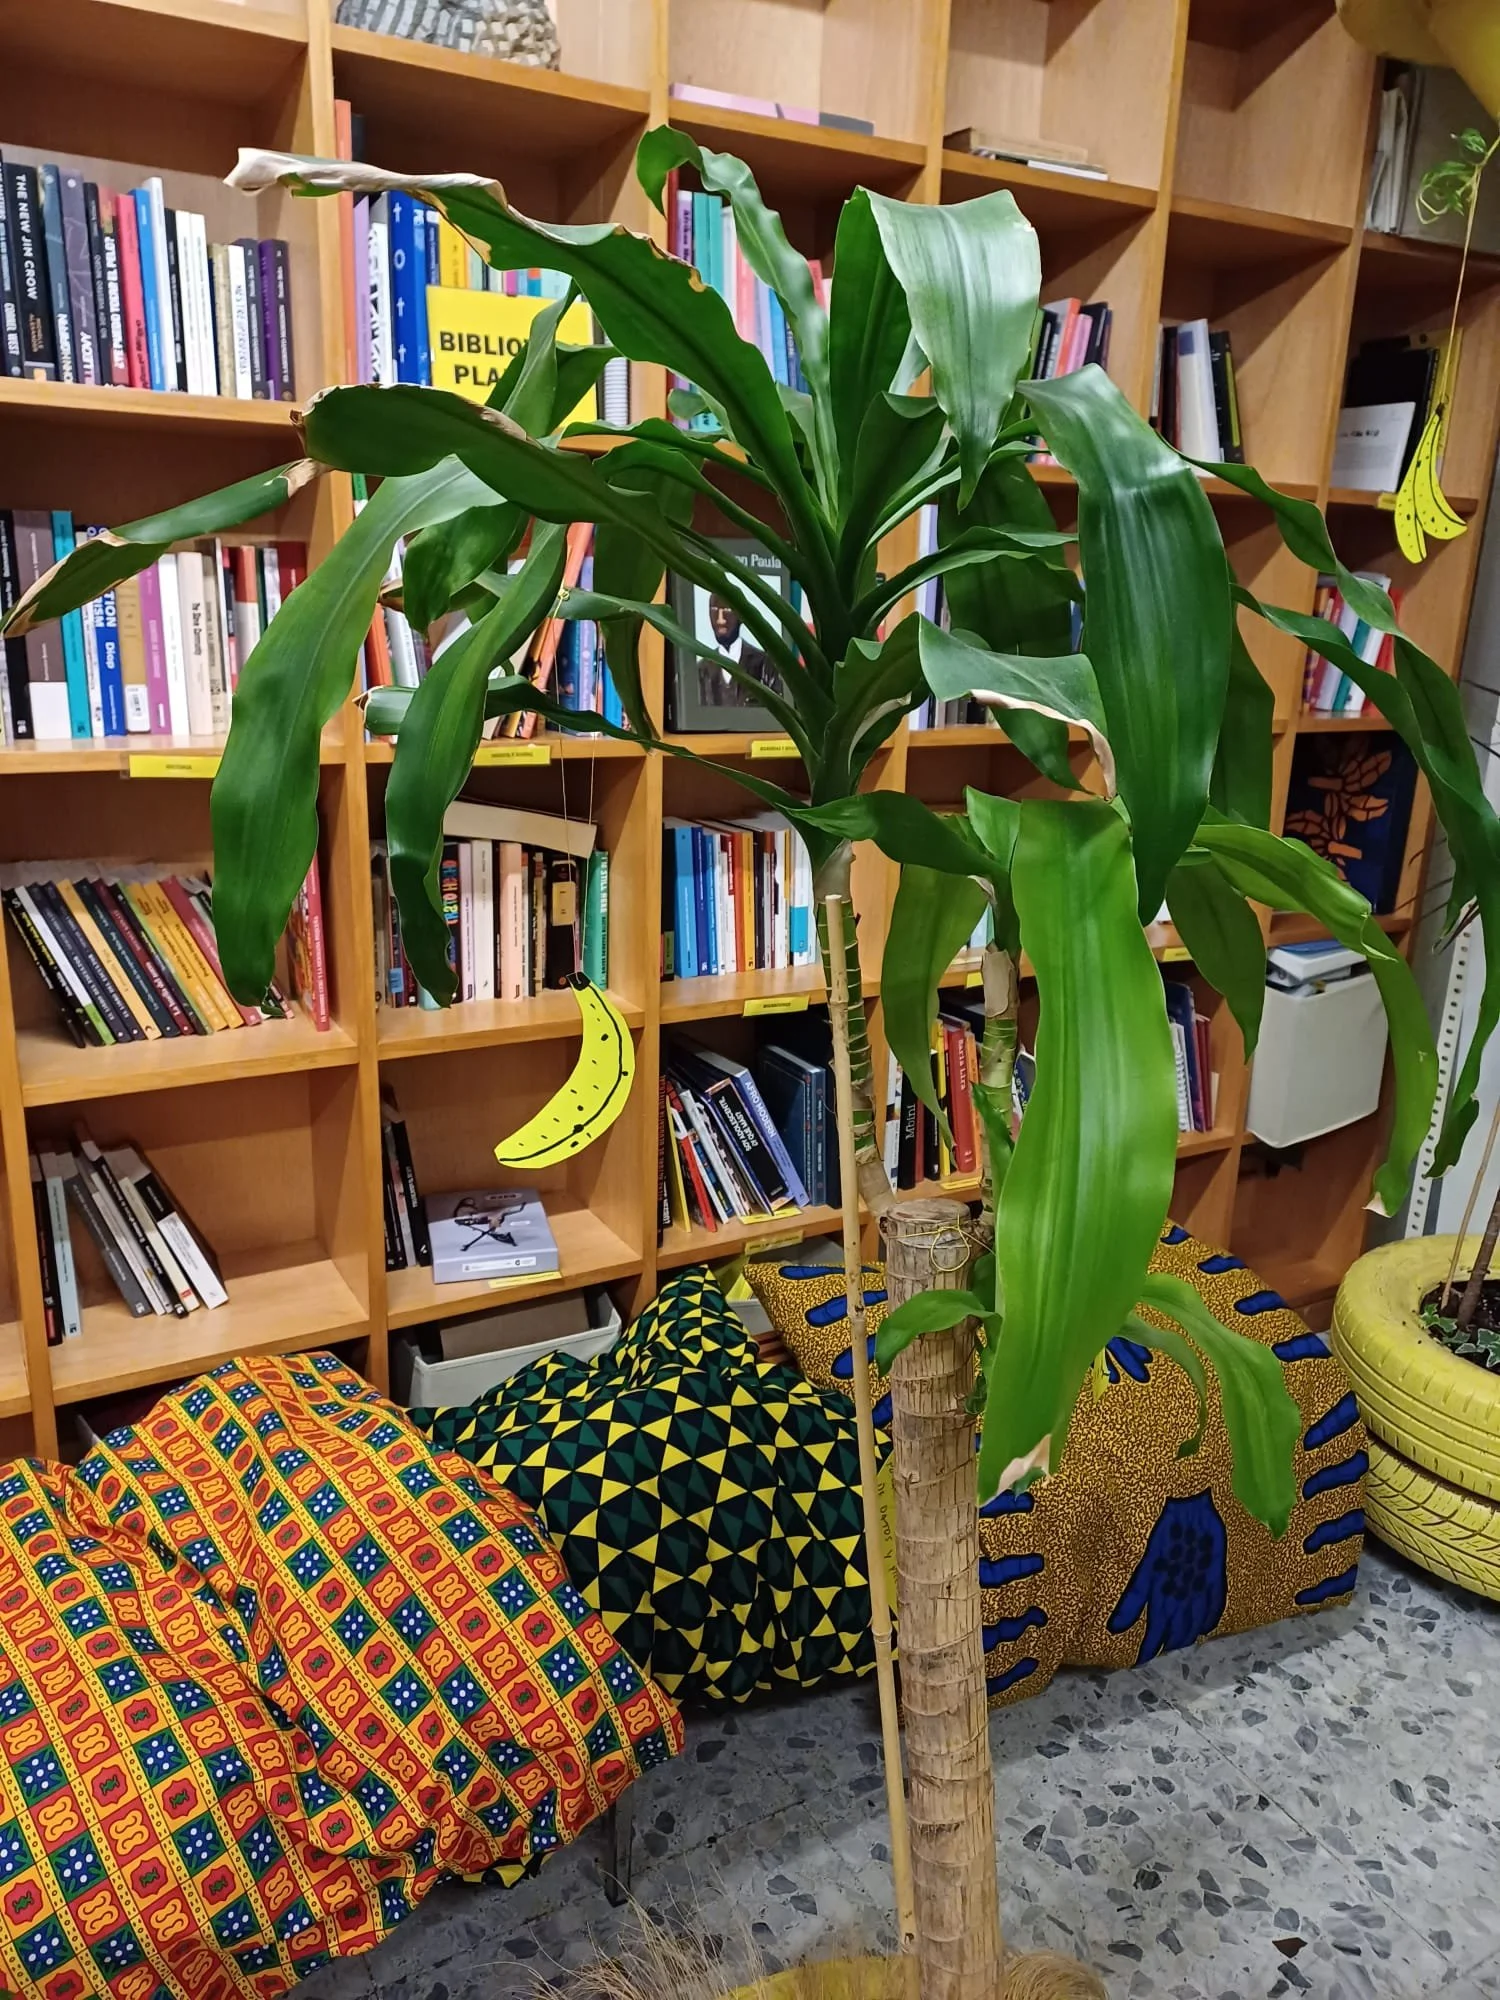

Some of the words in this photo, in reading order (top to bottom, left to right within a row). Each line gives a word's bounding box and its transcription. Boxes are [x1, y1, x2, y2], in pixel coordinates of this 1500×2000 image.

[15, 174, 27, 199] THE
[18, 201, 30, 233] NEW
[23, 260, 37, 300] CROW
[7, 332, 19, 356] WEST
[440, 330, 528, 358] BIBLIO
[454, 363, 501, 387] PLA
[191, 602, 200, 610] The
[192, 627, 203, 655] Community
[103, 641, 116, 669] Diop
[599, 870, 607, 890] STILL
[599, 892, 607, 913] HERE
[744, 1080, 760, 1103] AFRO
[753, 1100, 777, 1139] MODERN
[741, 1138, 752, 1151] SOY
